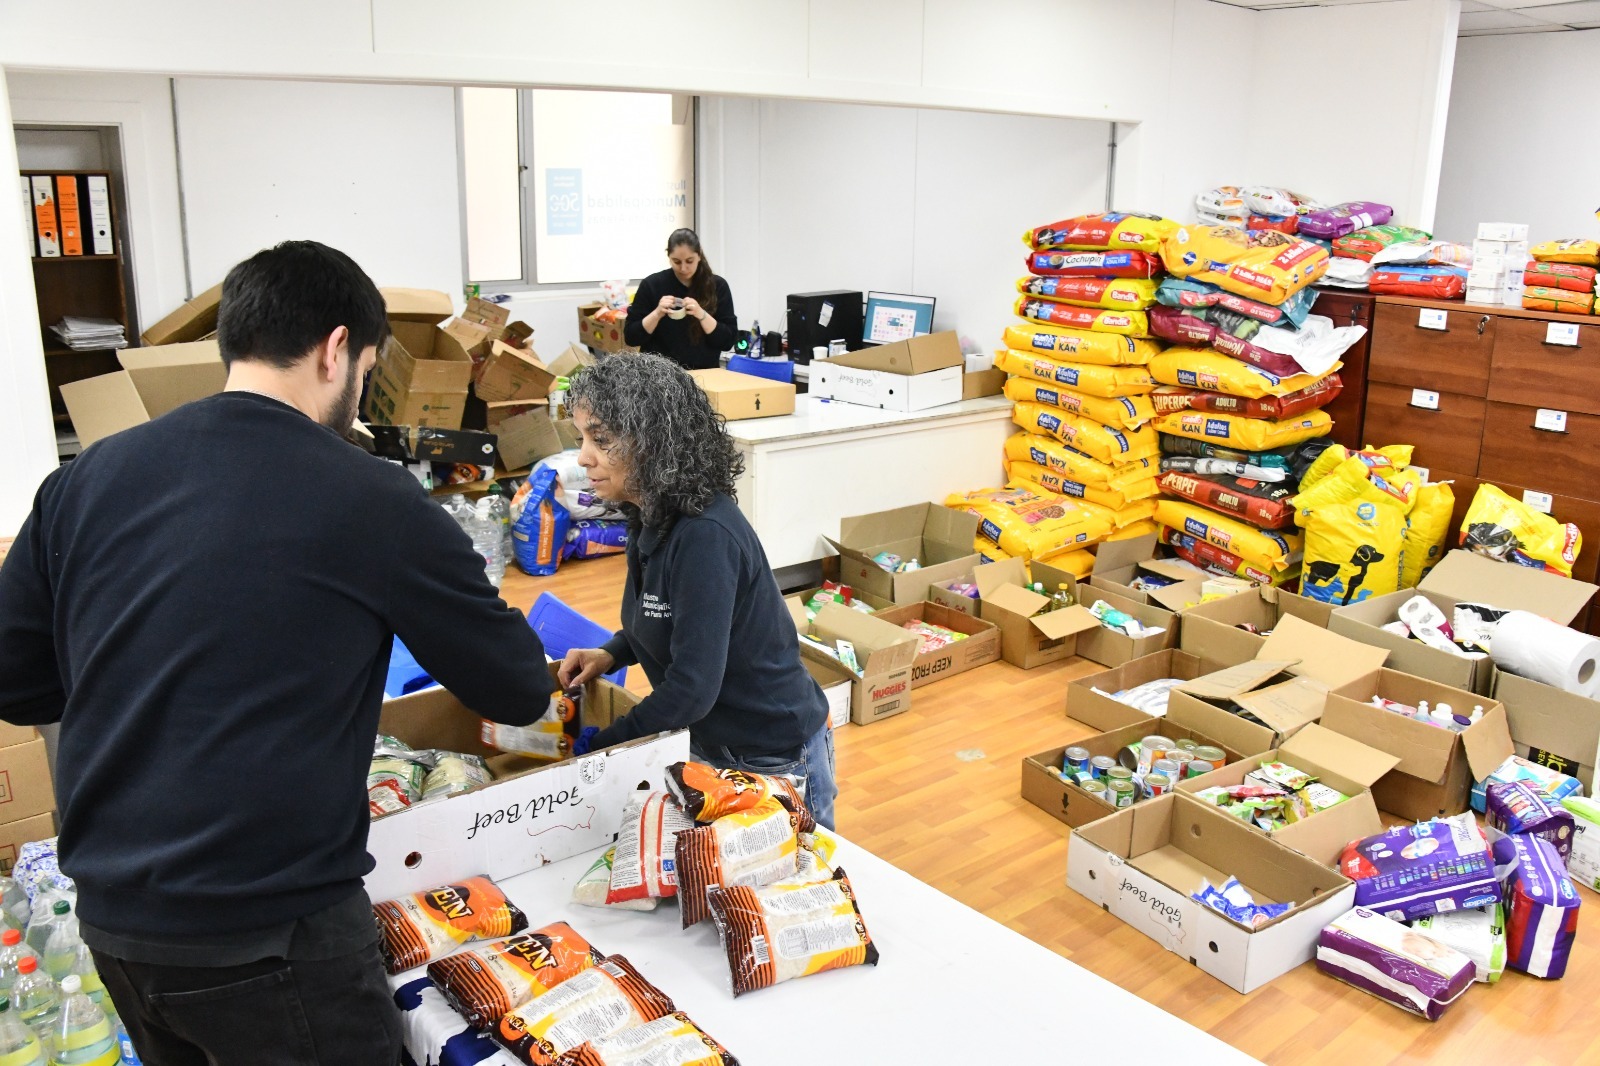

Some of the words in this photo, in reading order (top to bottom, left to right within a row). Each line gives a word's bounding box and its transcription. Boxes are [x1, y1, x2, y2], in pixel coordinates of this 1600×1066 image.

[1065, 256, 1102, 265] Cochupin
[1278, 255, 1286, 264] 2
[1112, 291, 1137, 301] Bandit
[1251, 308, 1275, 319] ADULTO
[1103, 316, 1129, 326] Bandit
[1058, 343, 1076, 353] KAN
[1214, 335, 1245, 355] Nómad
[1034, 367, 1051, 379] KAN
[1057, 367, 1077, 378] Adultos
[1200, 381, 1218, 391] KAN
[1037, 392, 1056, 401] Adultos
[1061, 394, 1080, 405] SABRO
[1152, 394, 1193, 412] SUPERPE
[1215, 397, 1237, 407] ADULTO
[1062, 402, 1079, 413] KAN
[1040, 414, 1058, 427] Adultos
[1207, 421, 1227, 431] Adultos
[1181, 423, 1201, 434] KAN
[1042, 474, 1060, 486] KAN
[1218, 493, 1239, 506] ADULTO
[1186, 520, 1206, 534] Adultos
[1210, 529, 1231, 541] SABRO
[1563, 523, 1580, 560] Bandit
[1210, 537, 1229, 550] KAN
[1246, 568, 1270, 584] Bandit
[932, 656, 952, 673] KEEP
[872, 682, 906, 701] HUGGIES
[525, 786, 584, 820] Gold
[466, 803, 522, 840] Beef
[1118, 878, 1147, 903] Beef
[431, 885, 474, 920] EN
[1463, 895, 1497, 908] Cotidian
[1149, 898, 1182, 922] Gold
[855, 916, 868, 942] YEN
[512, 934, 559, 971] EN
[507, 1014, 528, 1033] YEN
